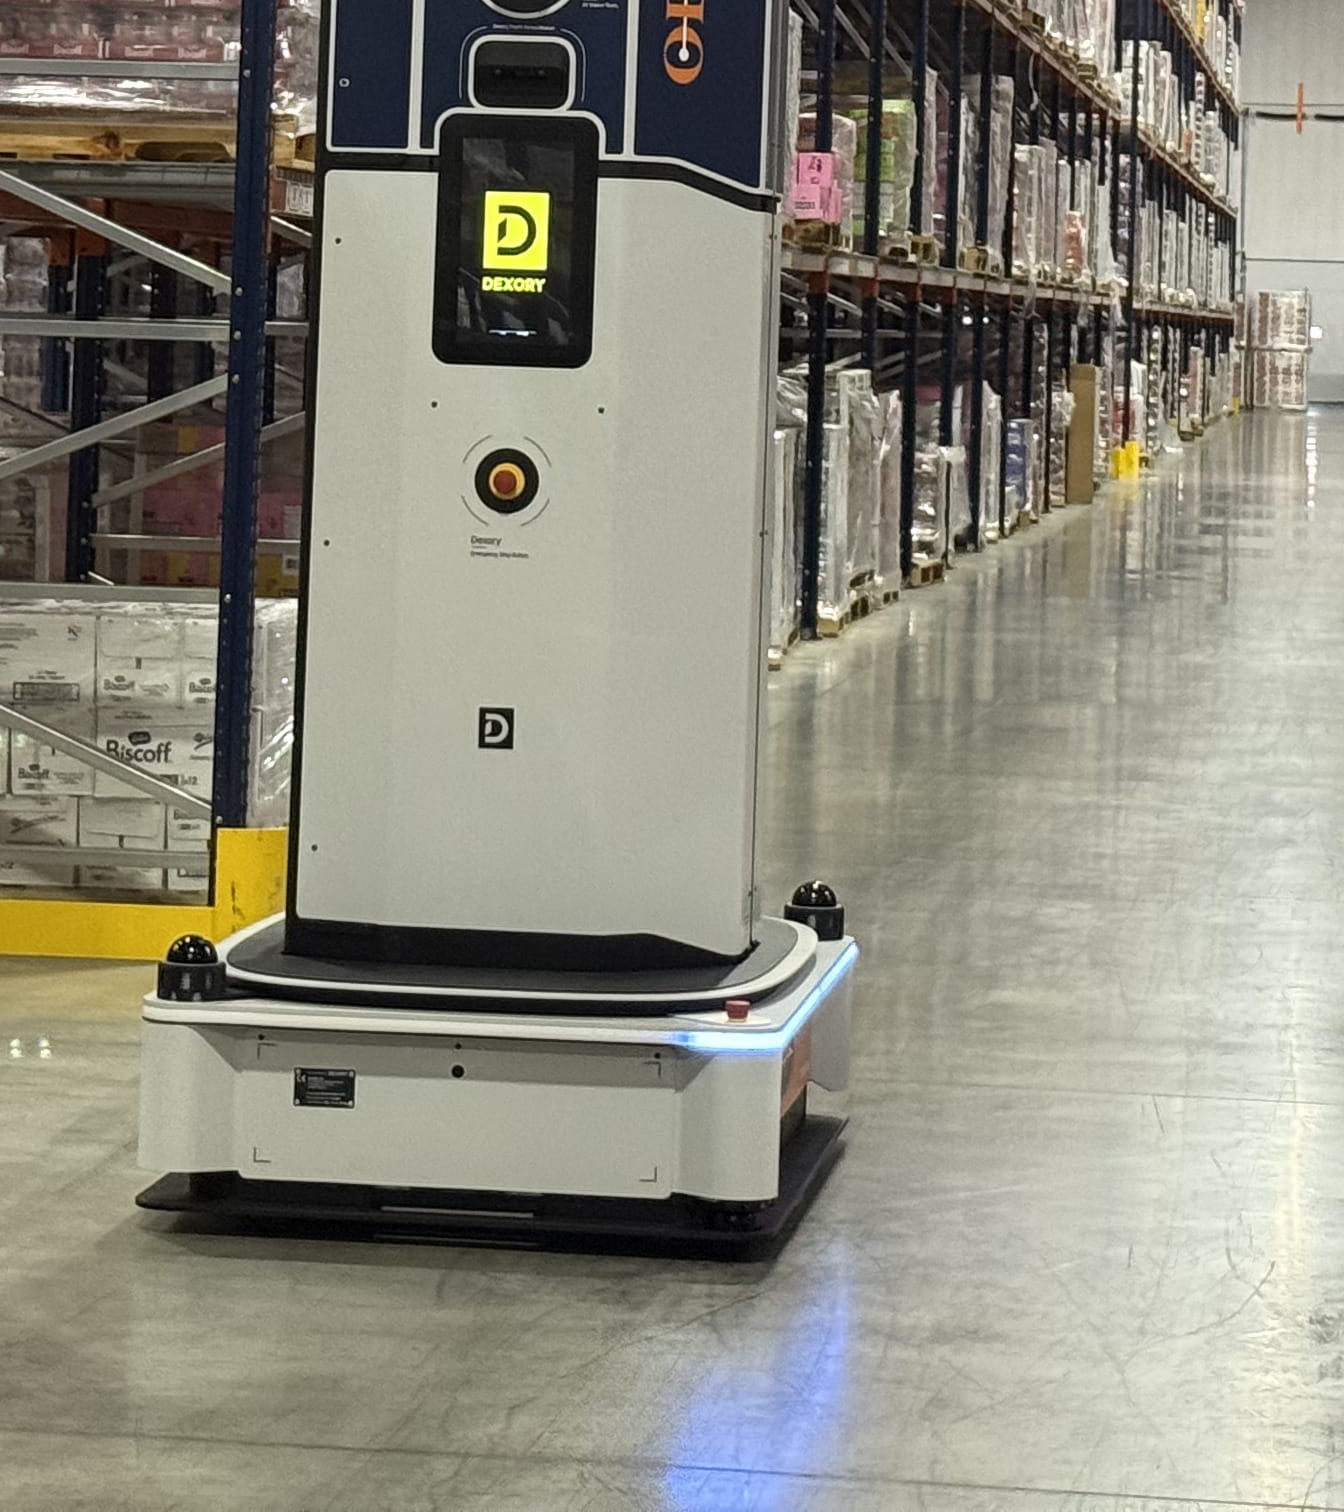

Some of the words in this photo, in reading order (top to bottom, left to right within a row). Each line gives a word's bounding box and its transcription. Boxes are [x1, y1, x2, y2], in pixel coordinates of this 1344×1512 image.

[481, 276, 546, 293] DEXORY
[470, 535, 503, 546] Dexory
[106, 739, 172, 764] Biscoff
